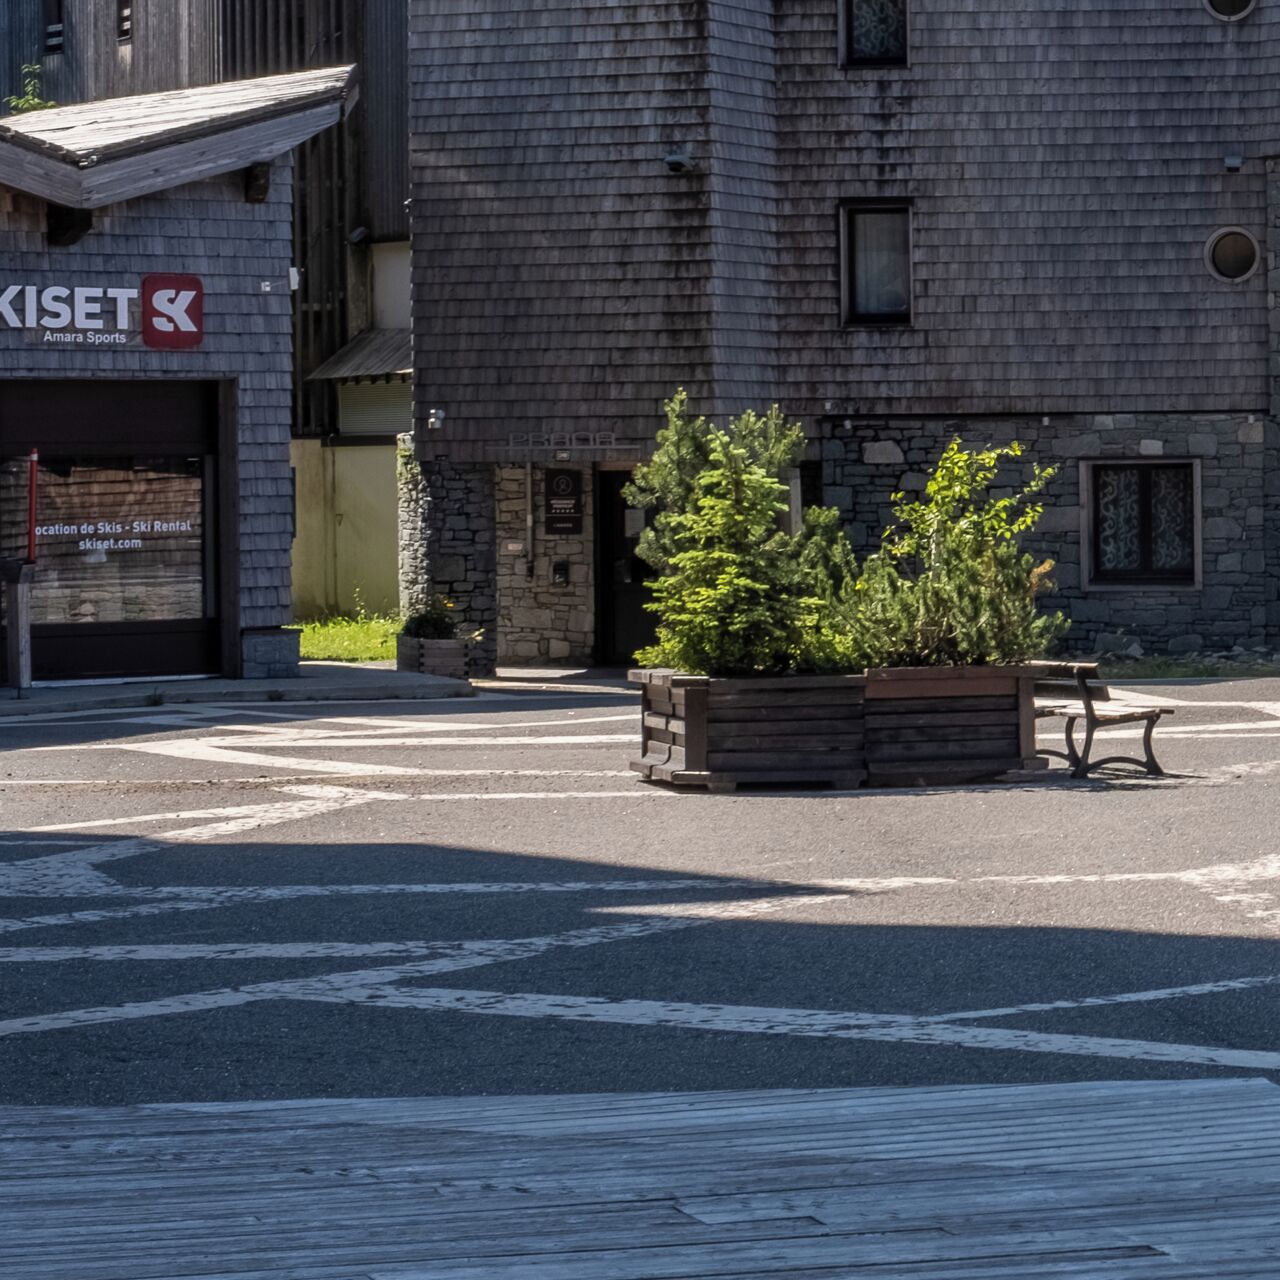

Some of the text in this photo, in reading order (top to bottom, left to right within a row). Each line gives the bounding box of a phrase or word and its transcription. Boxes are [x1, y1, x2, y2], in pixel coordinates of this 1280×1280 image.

[43, 331, 126, 345] Amara Sports
[35, 523, 77, 535] ocation
[80, 523, 94, 534] de
[97, 522, 122, 533] Skis
[133, 521, 150, 533] Ski
[153, 520, 191, 532] Rental
[79, 538, 141, 550] skiset.com
